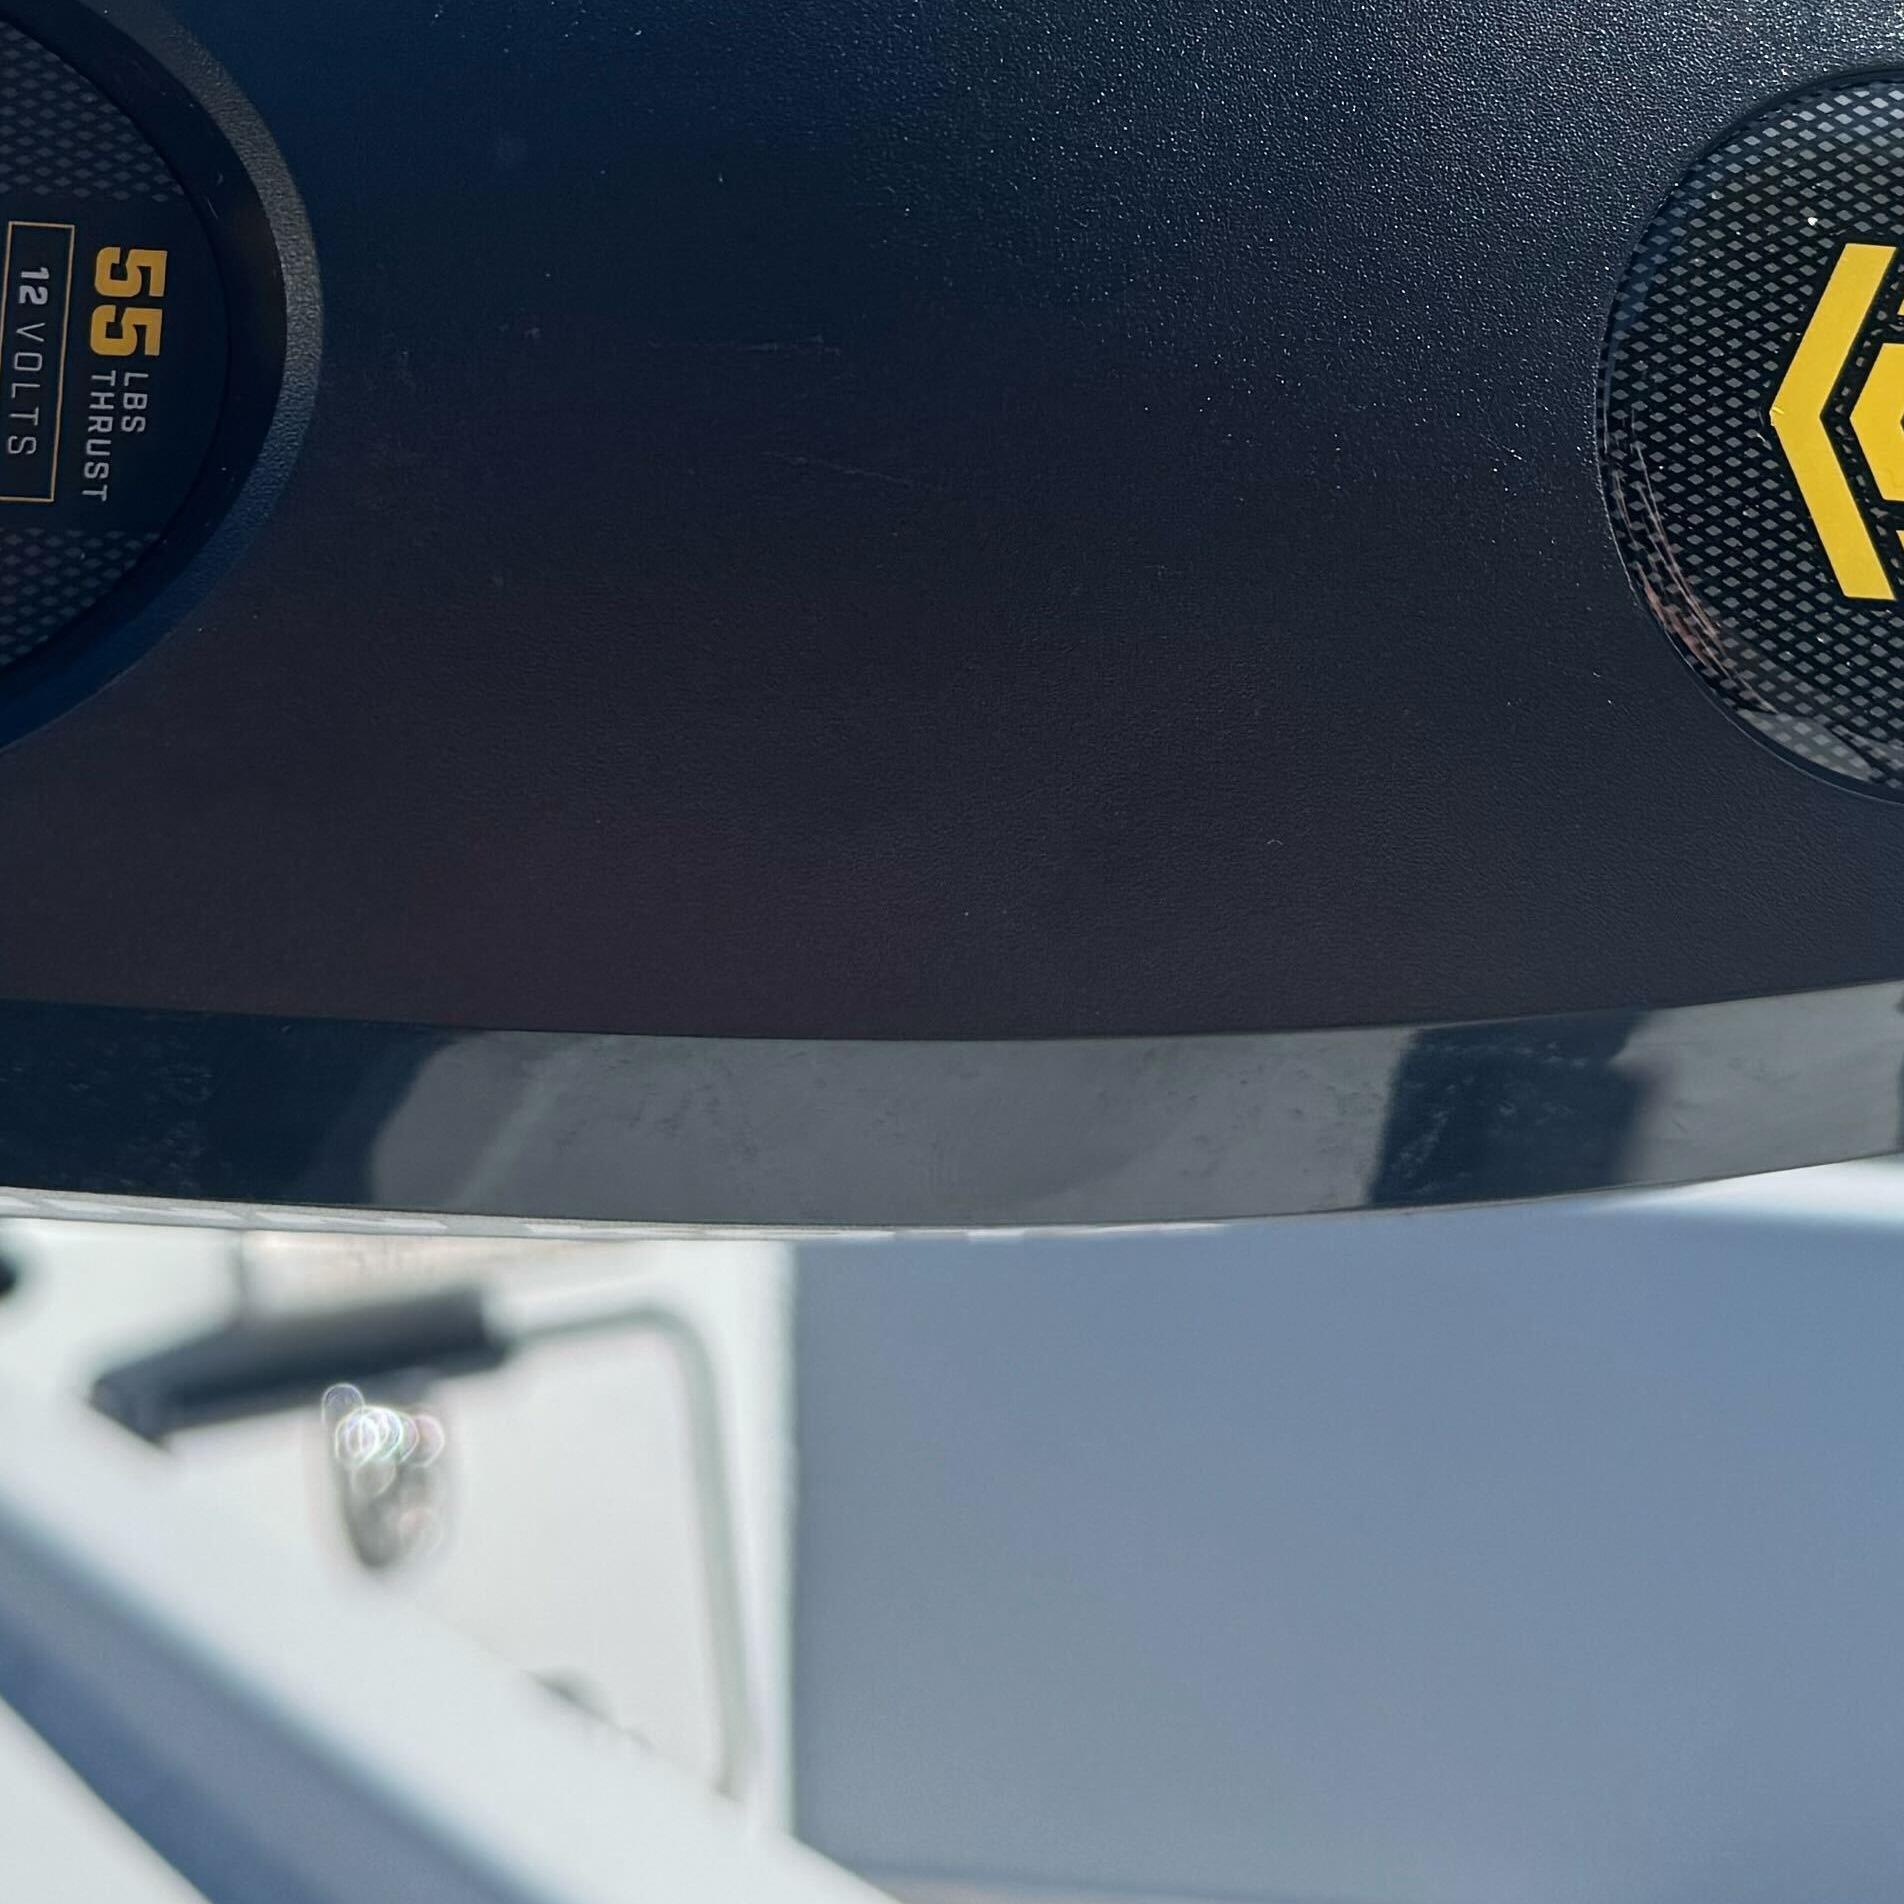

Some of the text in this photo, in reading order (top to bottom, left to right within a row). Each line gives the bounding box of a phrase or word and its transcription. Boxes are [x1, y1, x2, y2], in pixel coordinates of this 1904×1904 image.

[7, 266, 51, 456] 12 VOLTS
[89, 246, 167, 357] 55
[81, 368, 118, 502] THRUST
[120, 370, 150, 433] LBS
